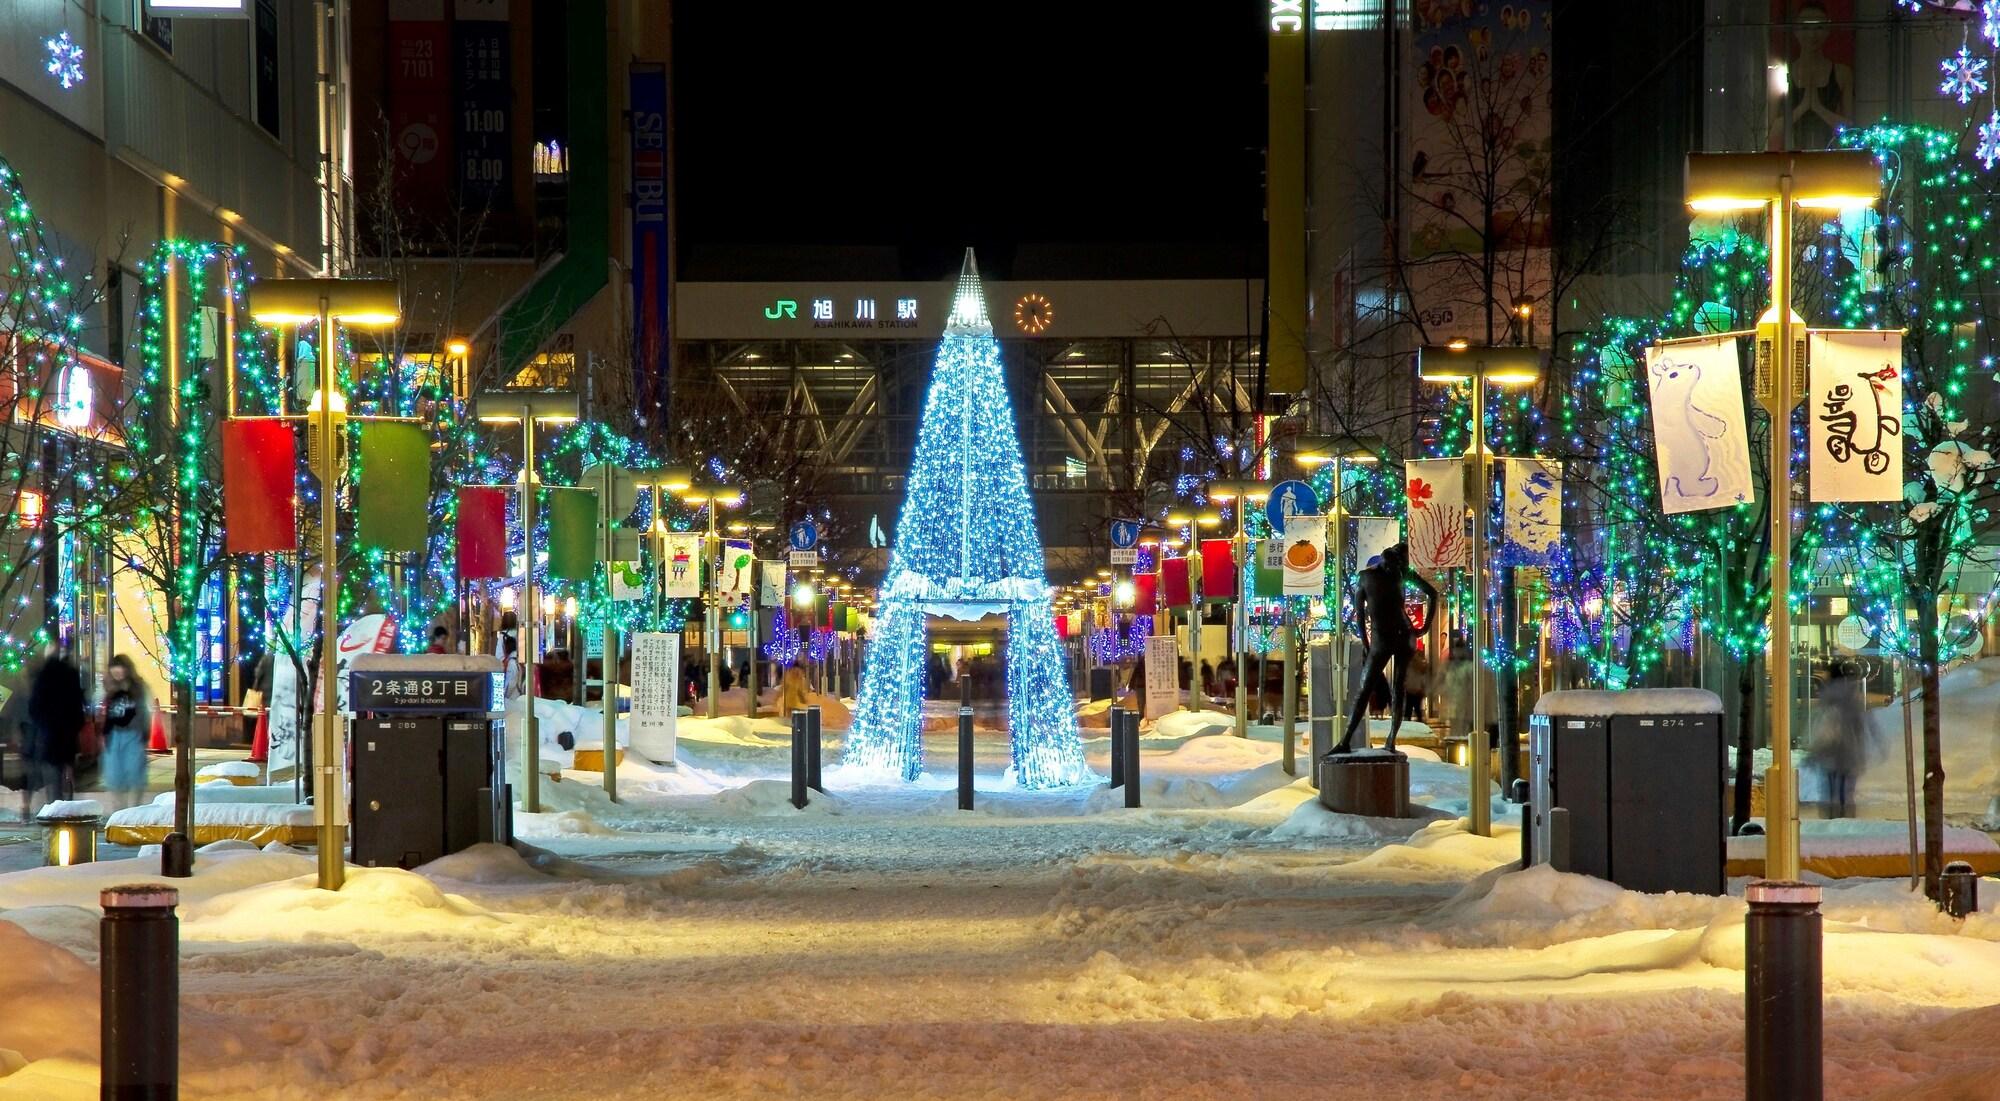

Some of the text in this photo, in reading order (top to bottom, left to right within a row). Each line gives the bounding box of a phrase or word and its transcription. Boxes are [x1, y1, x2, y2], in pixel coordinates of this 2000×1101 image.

[415, 39, 433, 58] 23
[401, 60, 433, 80] 7101
[464, 37, 476, 91] レストラン
[463, 109, 504, 133] 11:00
[466, 158, 503, 181] 8:00
[633, 111, 665, 225] SEIBU
[765, 299, 917, 319] JR 旭川駅
[813, 320, 918, 329] ASAHIKAWA STATION
[372, 680, 468, 696] 2条通8丁目
[1662, 719, 1684, 727] 274
